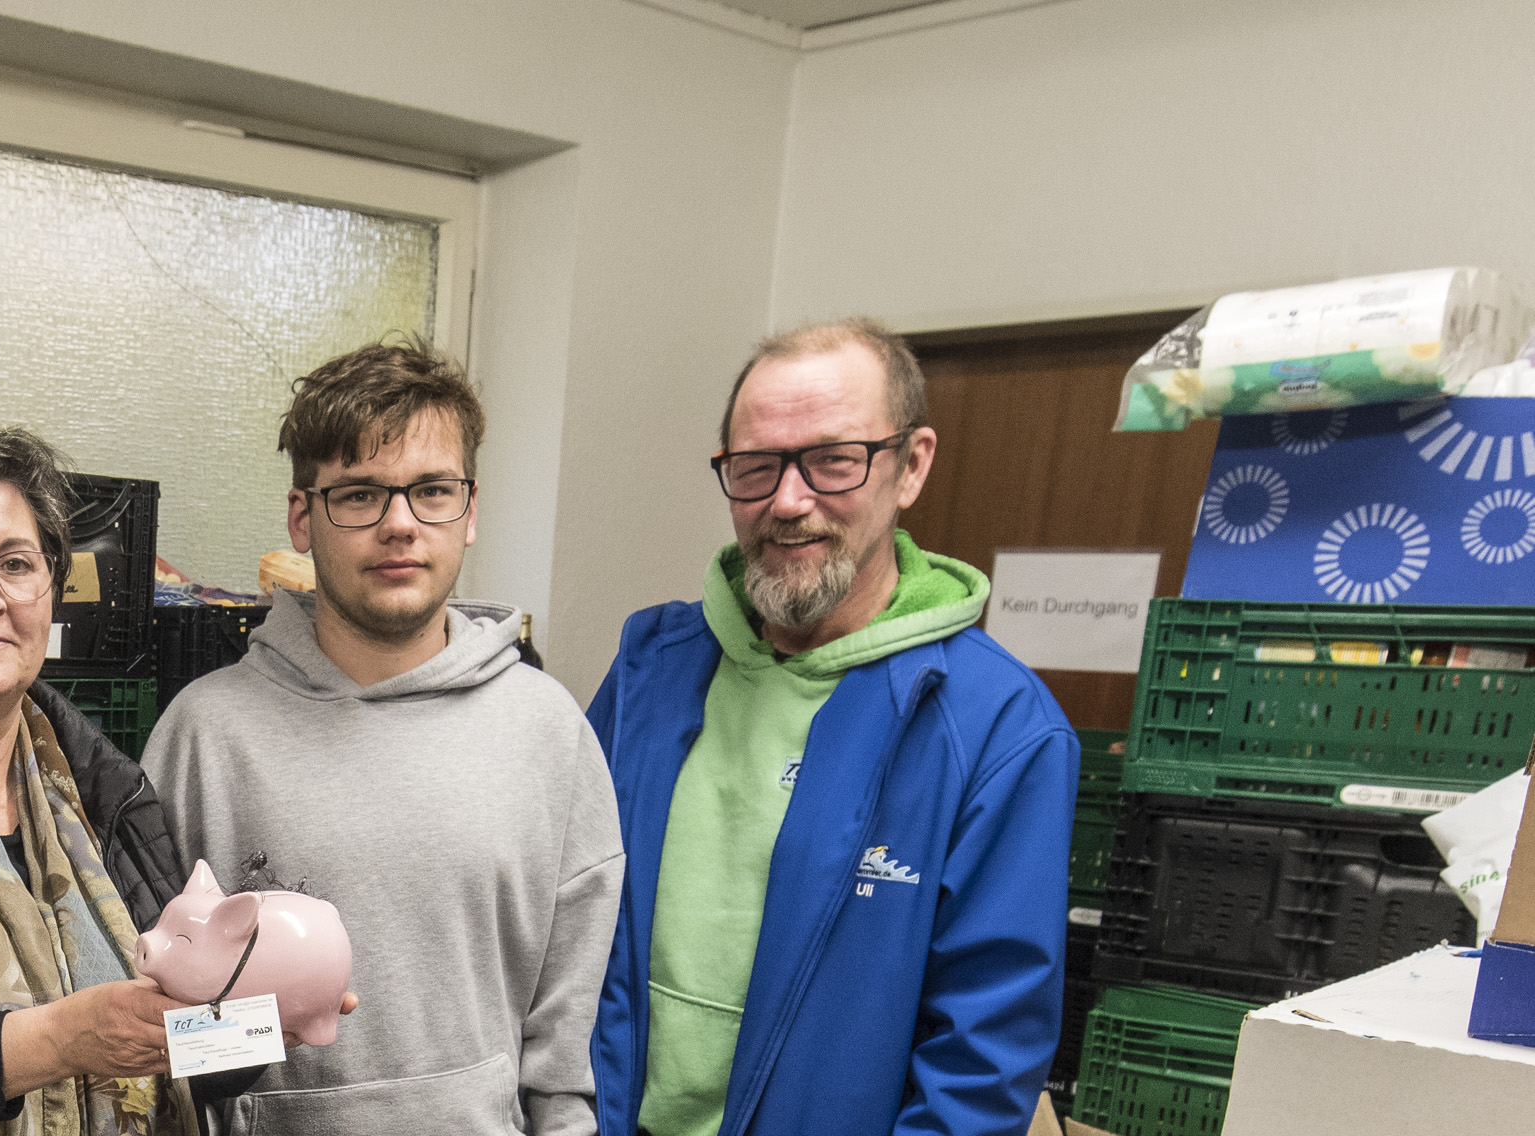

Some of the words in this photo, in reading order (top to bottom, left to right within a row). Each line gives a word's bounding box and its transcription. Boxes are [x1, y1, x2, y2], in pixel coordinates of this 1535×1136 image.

[1002, 596, 1038, 613] Kein
[1043, 597, 1139, 619] Durchgang
[856, 882, 874, 898] Uli
[254, 1026, 273, 1036] PADI
